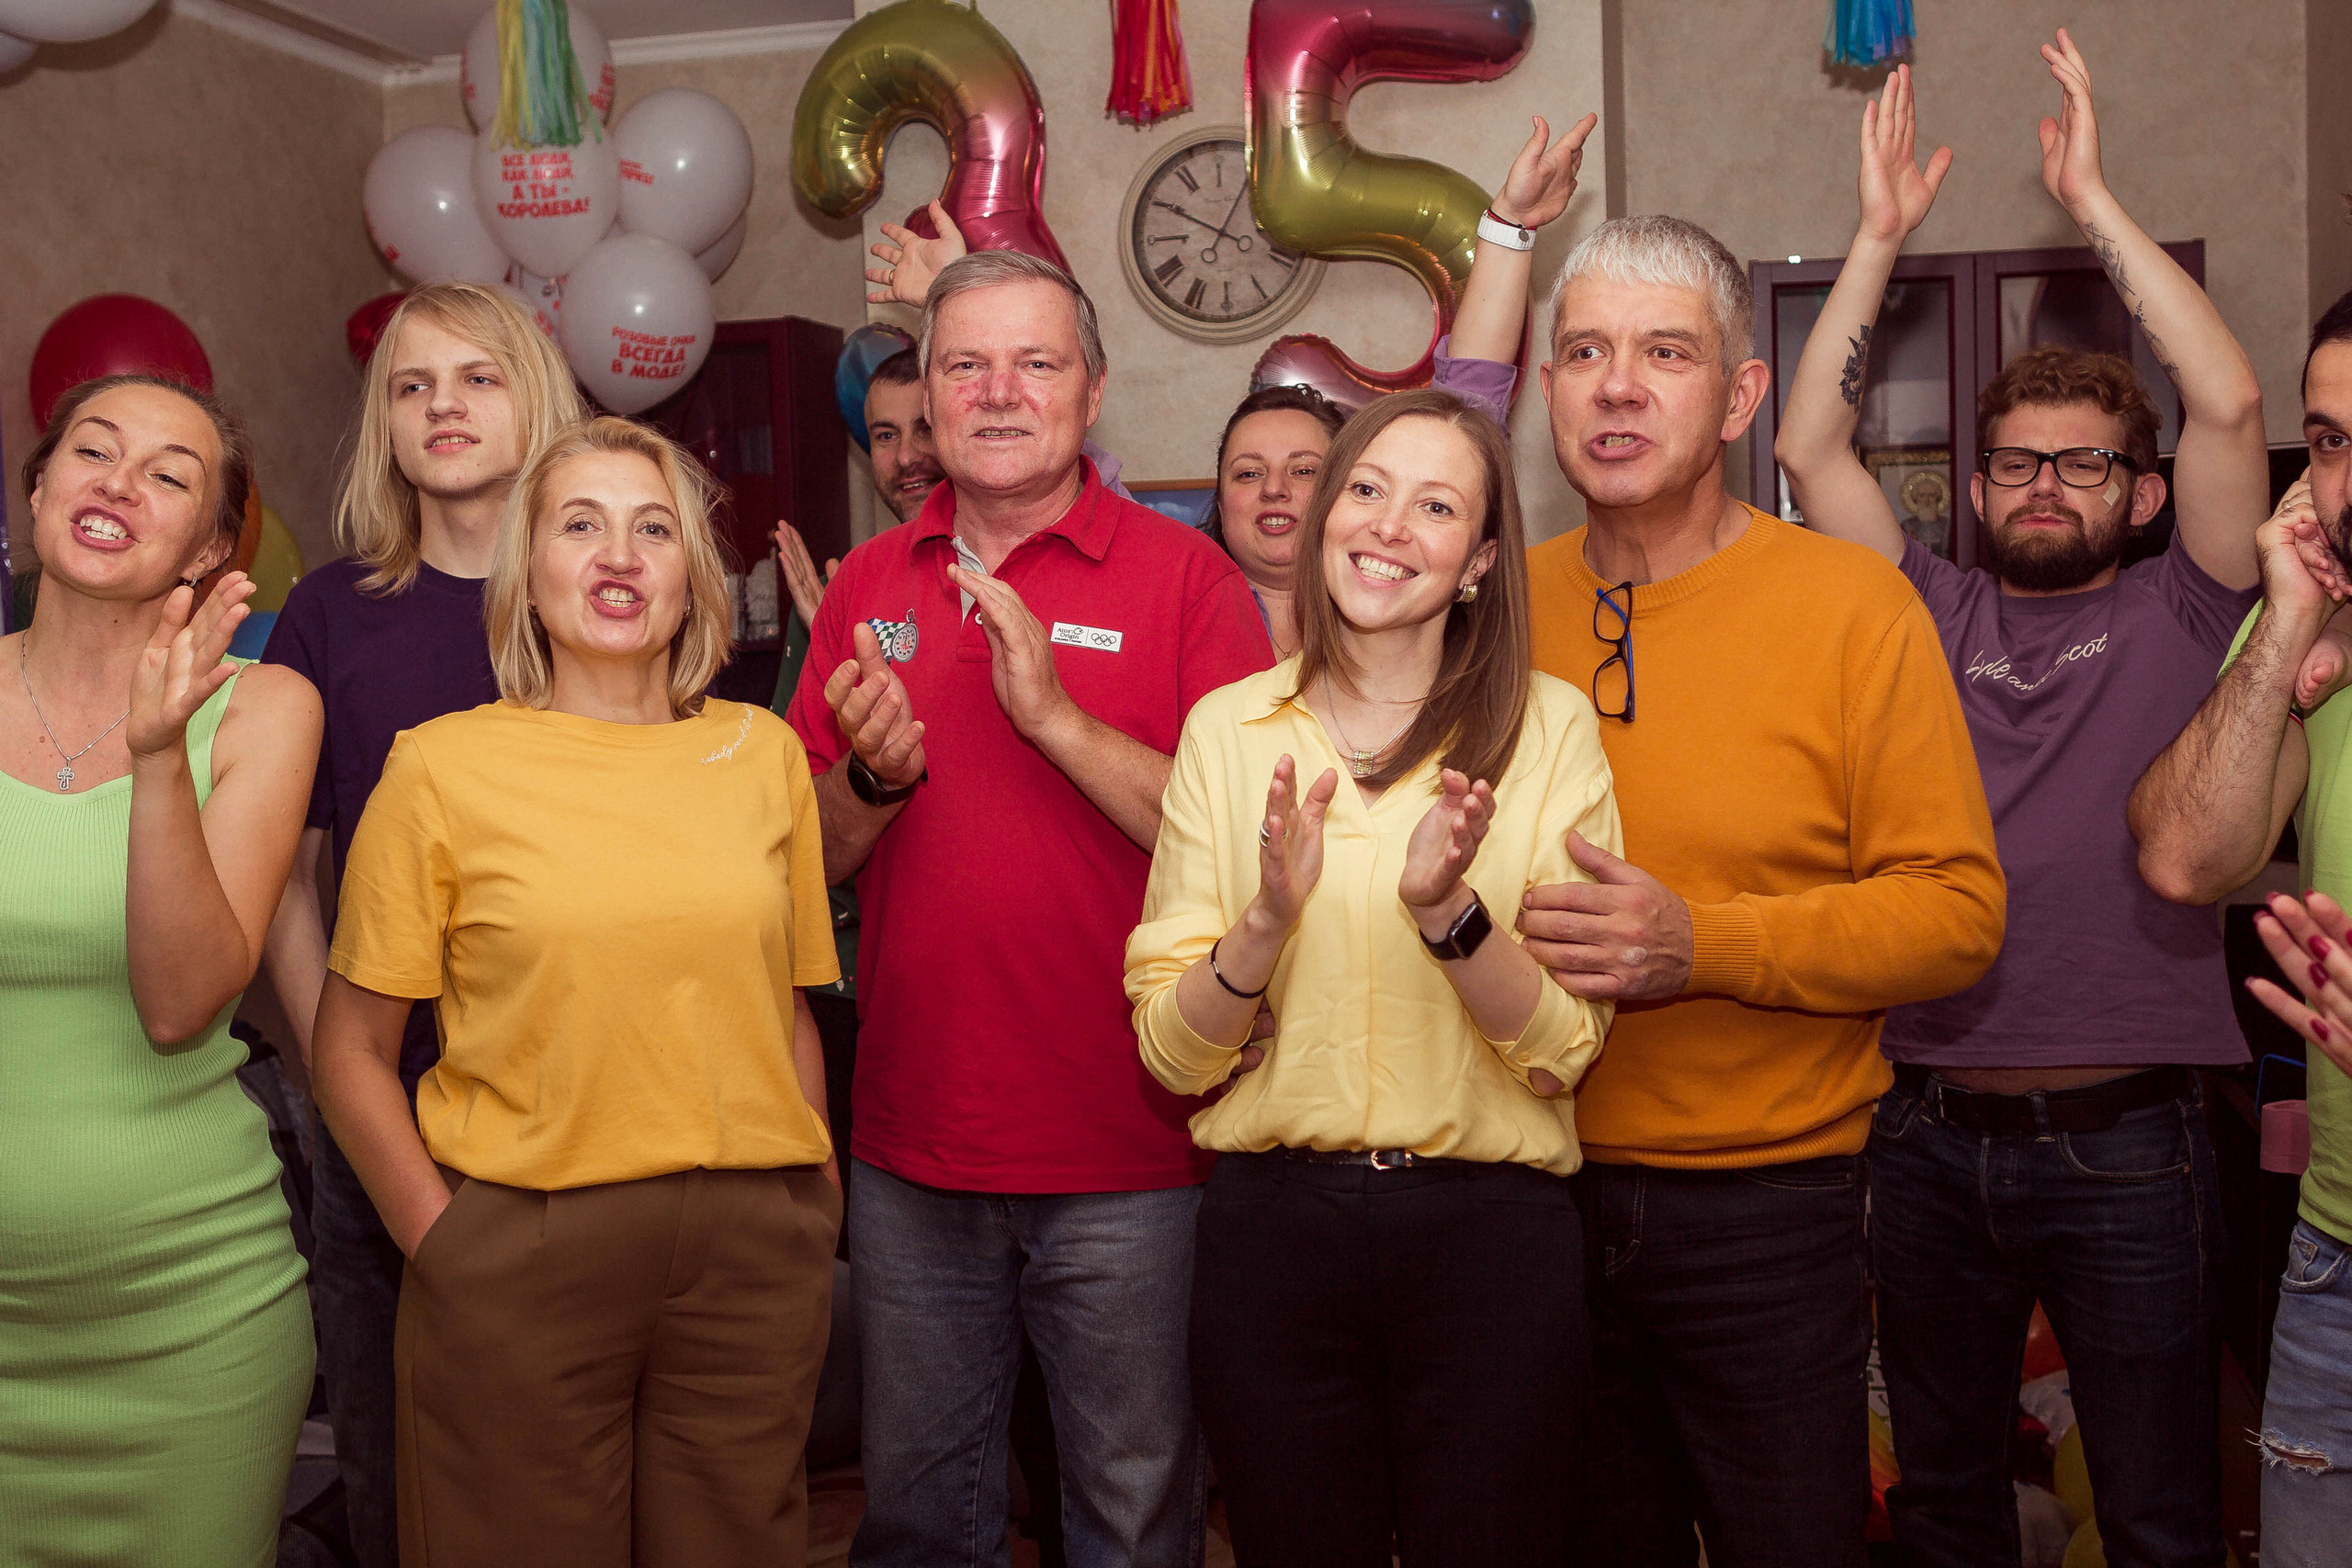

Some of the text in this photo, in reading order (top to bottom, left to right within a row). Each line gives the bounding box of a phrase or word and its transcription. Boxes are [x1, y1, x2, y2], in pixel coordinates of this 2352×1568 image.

[501, 152, 524, 166] ВСЕ
[512, 184, 525, 199] А
[528, 183, 556, 199] ТЫ
[497, 197, 590, 219] КОРОЛЕВА!
[618, 342, 685, 364] ВСЕГДА
[610, 358, 686, 379] В МОДЕ!
[1060, 632, 1080, 640] Origin
[1965, 649, 2011, 683] Lyle
